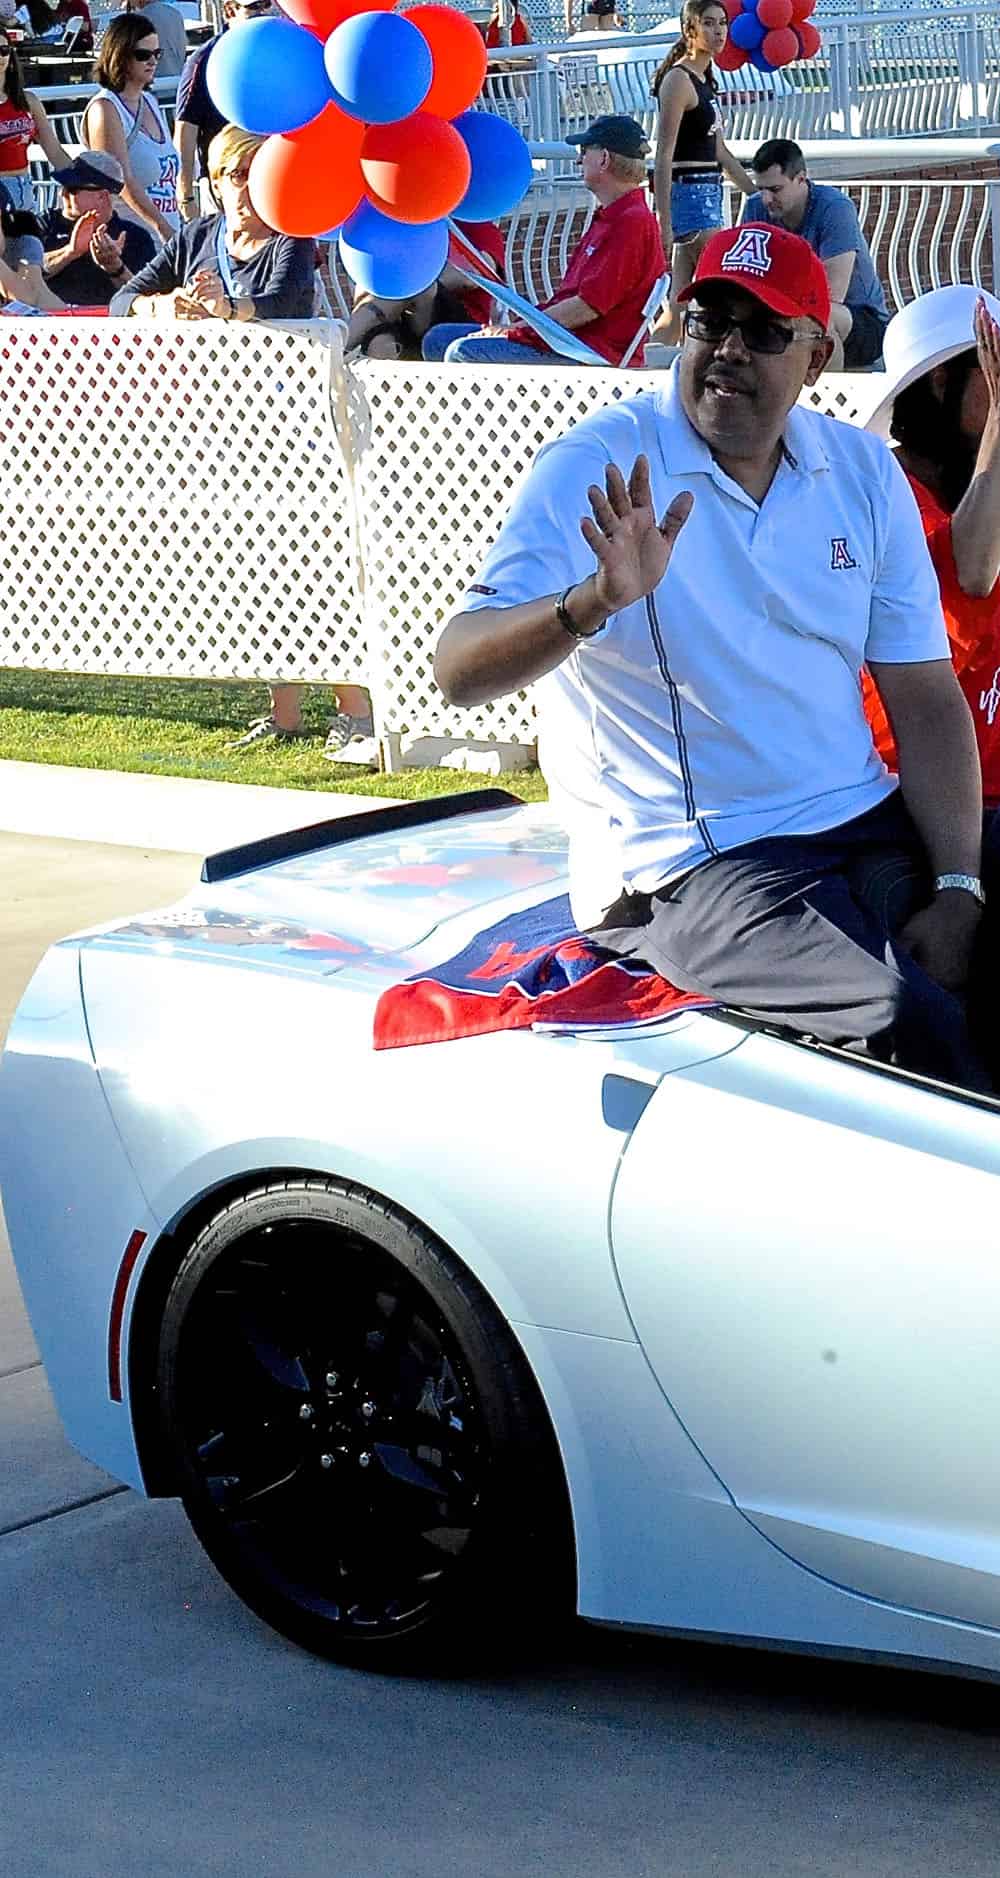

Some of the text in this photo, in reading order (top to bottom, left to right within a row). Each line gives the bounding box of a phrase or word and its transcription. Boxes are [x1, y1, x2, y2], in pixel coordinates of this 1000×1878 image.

[721, 228, 772, 272] A
[721, 265, 765, 278] FOOTBALL
[830, 537, 858, 570] A
